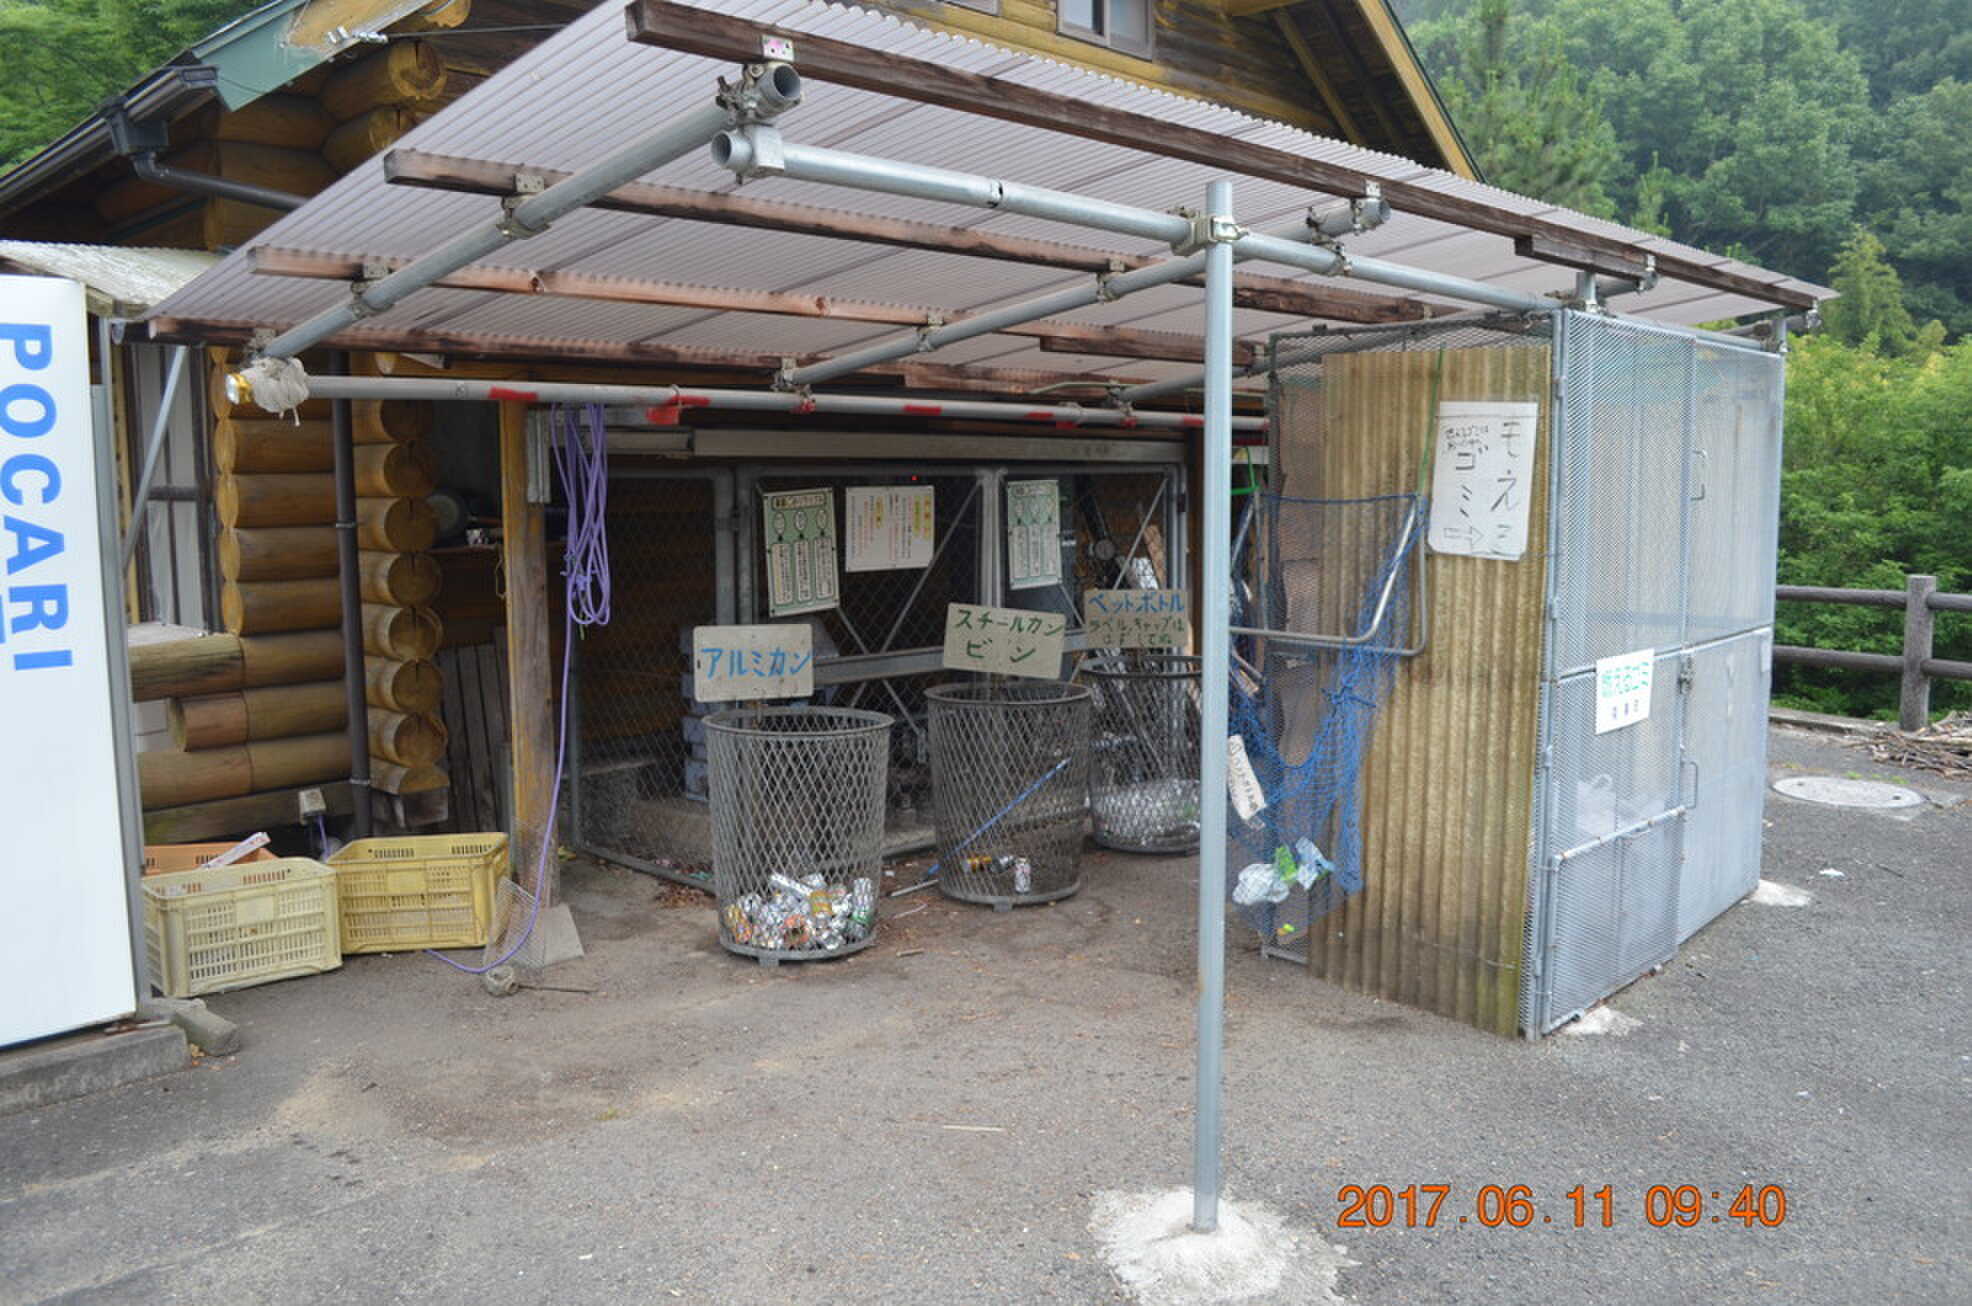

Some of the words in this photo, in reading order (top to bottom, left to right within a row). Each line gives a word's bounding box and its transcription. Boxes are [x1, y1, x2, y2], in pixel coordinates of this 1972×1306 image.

[0, 323, 73, 671] POCARI
[954, 609, 1064, 636] スチールカン
[701, 647, 816, 679] アルミカン
[966, 638, 1036, 663] ビン
